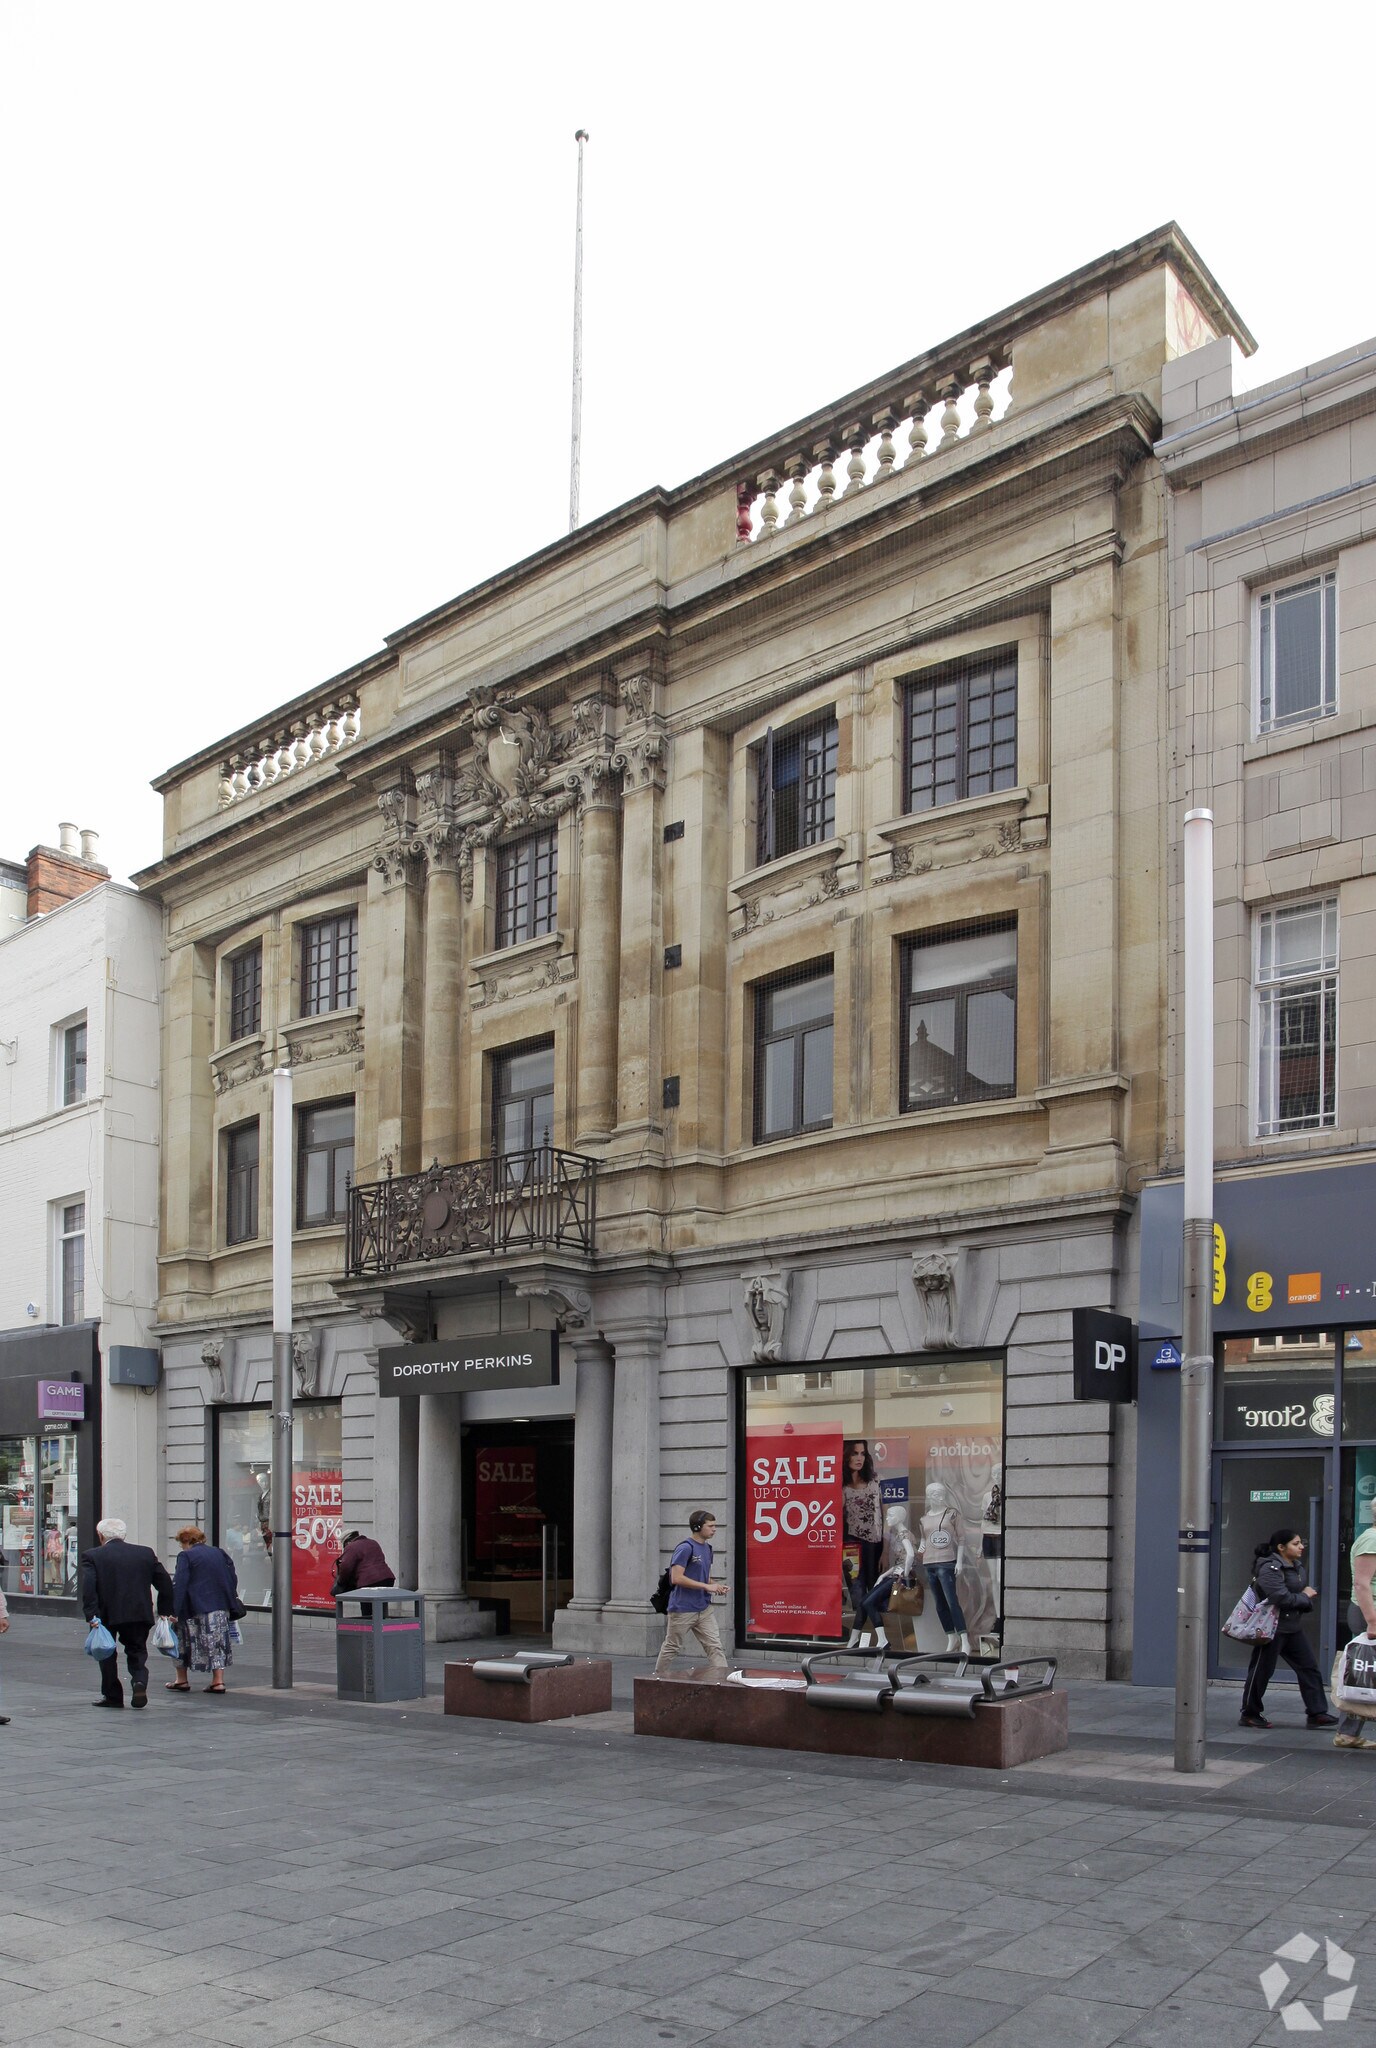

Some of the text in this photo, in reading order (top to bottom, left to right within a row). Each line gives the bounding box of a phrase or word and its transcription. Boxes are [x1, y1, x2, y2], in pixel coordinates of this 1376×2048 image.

[1289, 1293, 1317, 1302] orange
[1095, 1340, 1126, 1371] DP
[393, 1353, 533, 1377] DOROTHY PERKINS
[47, 1385, 81, 1397] GAME
[44, 1422, 69, 1432] game.co.uk
[478, 1461, 534, 1483] SALE
[752, 1455, 836, 1486] SALE
[294, 1484, 341, 1506] SALE
[753, 1486, 791, 1499] UP TO
[883, 1487, 905, 1498] £15
[295, 1507, 318, 1516] UP TO
[753, 1499, 836, 1543] 50%
[294, 1517, 342, 1550] 50%
[807, 1529, 837, 1543] OFF
[1187, 1531, 1194, 1539] 6
